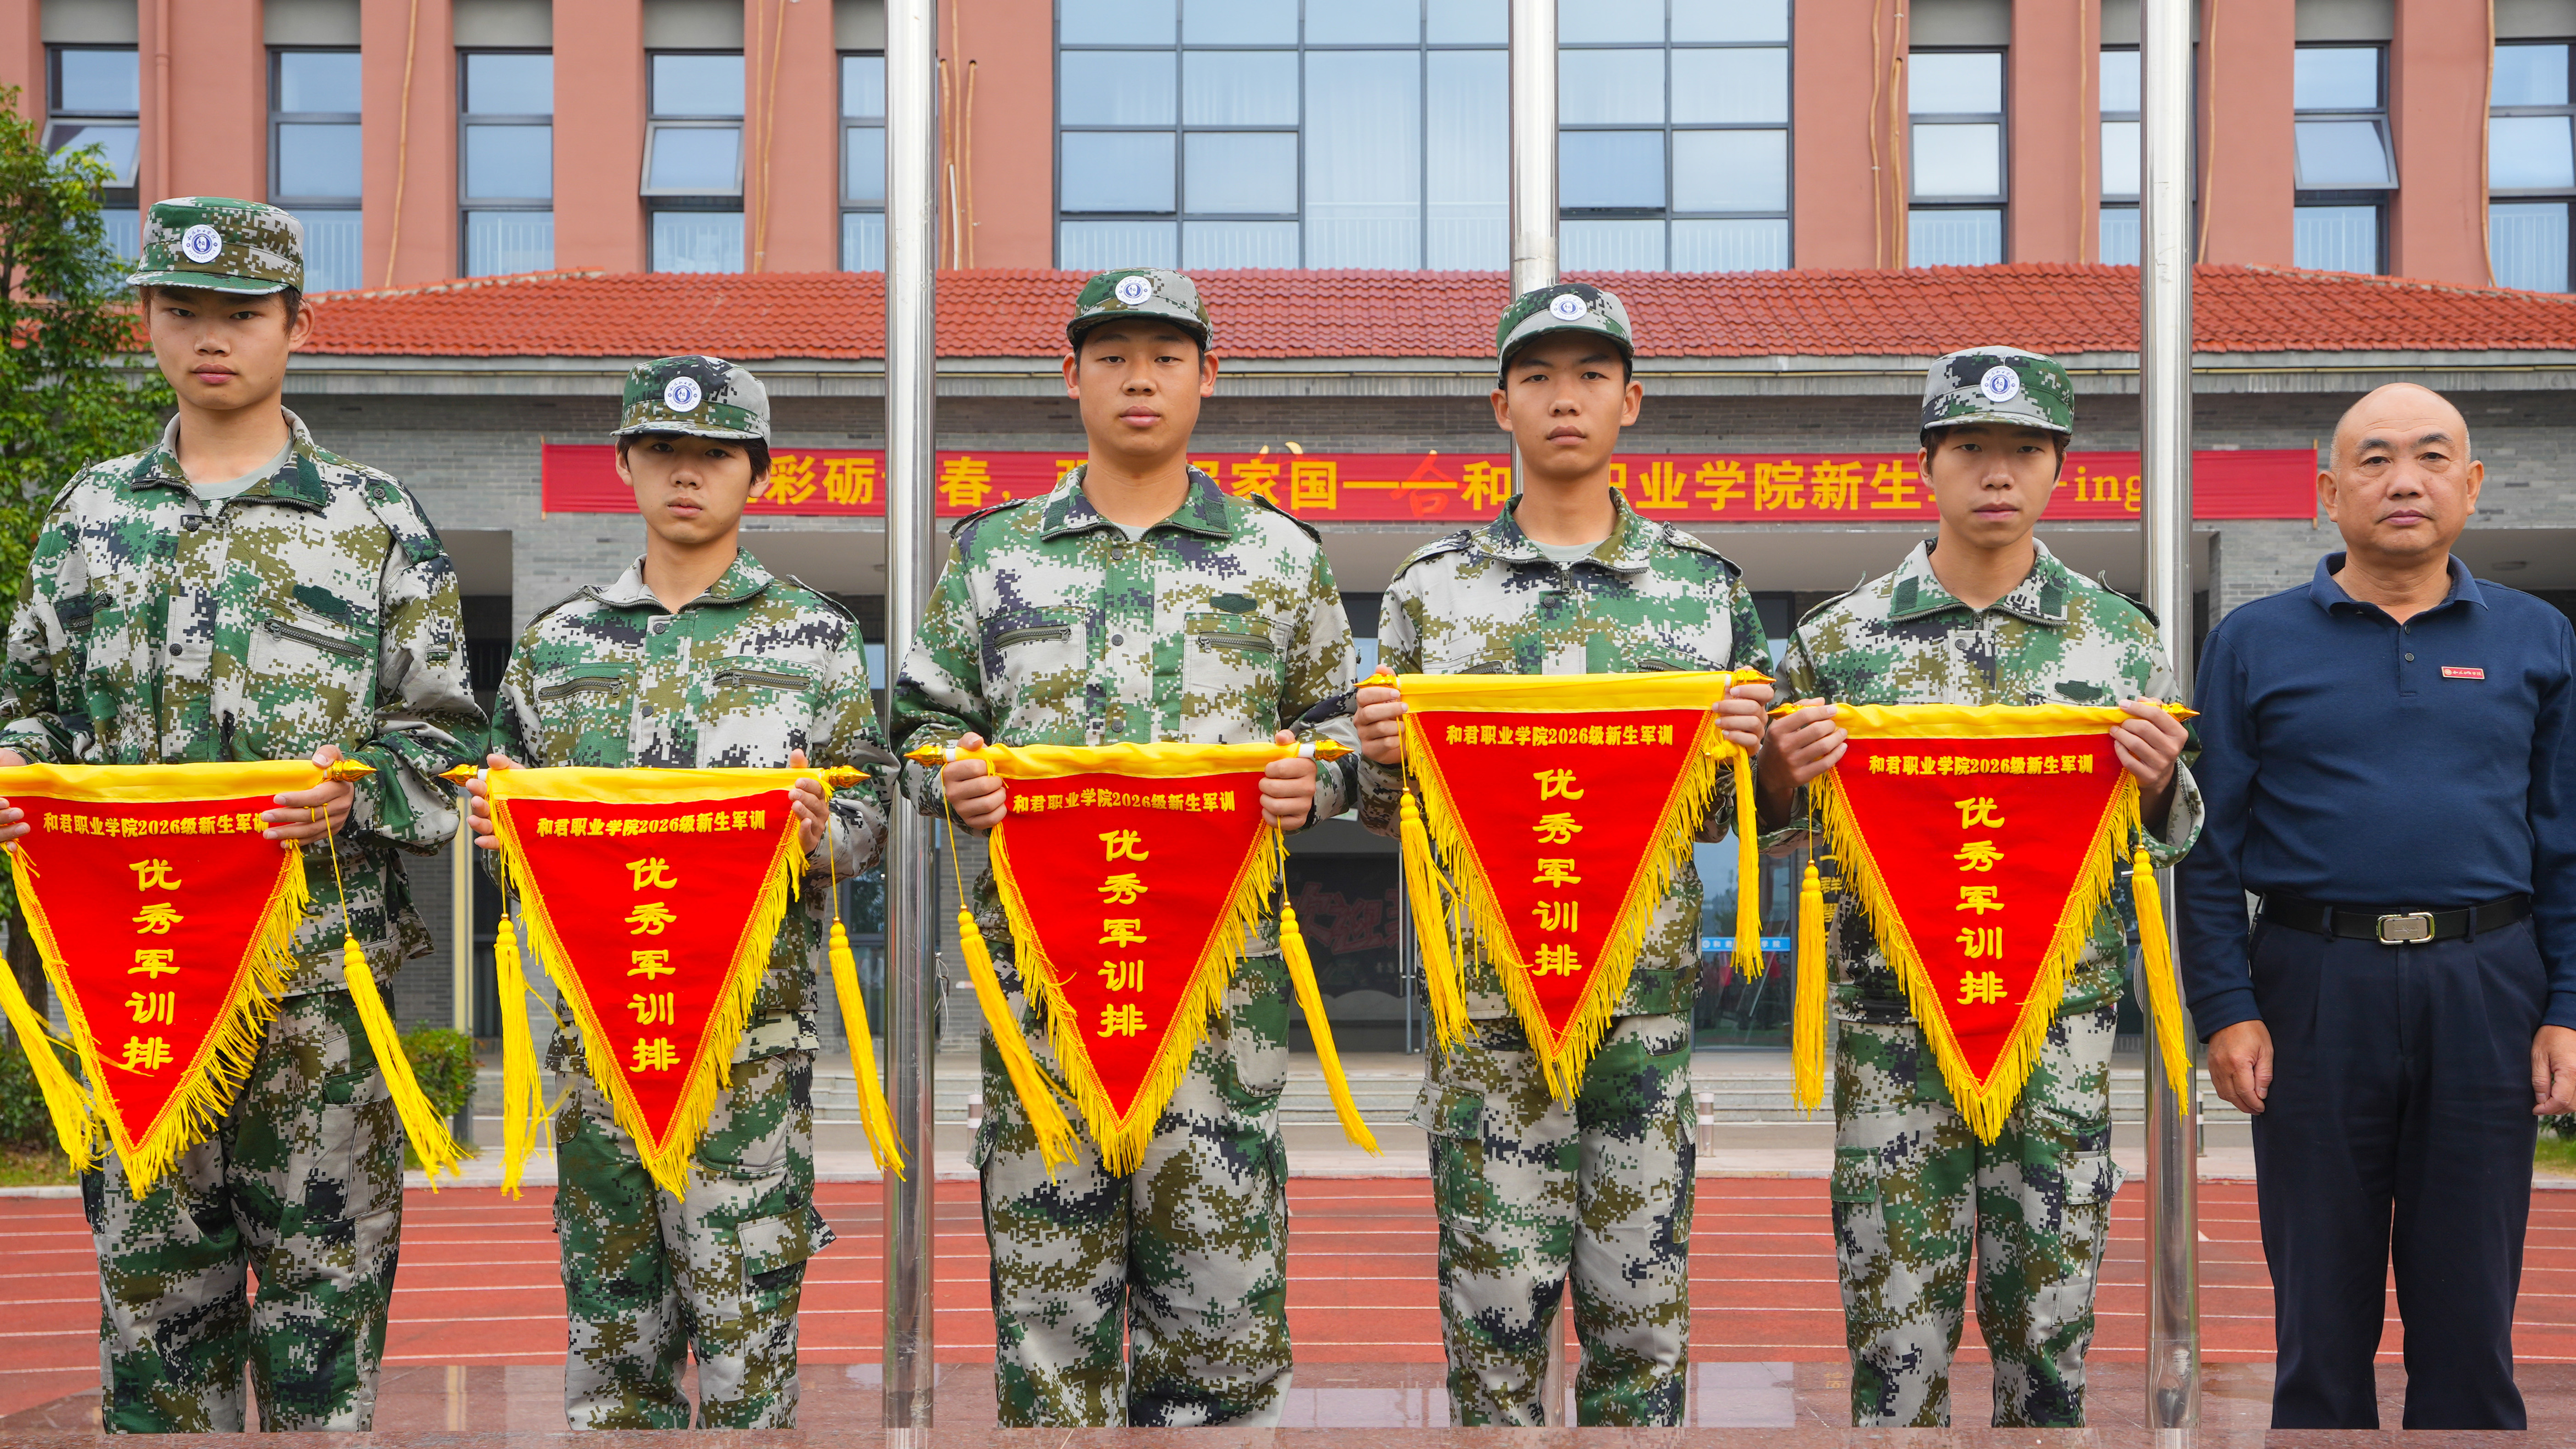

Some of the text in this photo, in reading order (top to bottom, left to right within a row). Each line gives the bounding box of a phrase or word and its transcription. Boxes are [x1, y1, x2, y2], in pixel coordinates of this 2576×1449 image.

[536, 810, 765, 838] 和君职业学院2026级新生军训
[1012, 788, 1236, 813] 和君职业学院2026级新生军训
[1446, 724, 1673, 747] 和君职业学院2026级新生军训
[1869, 754, 2093, 776] 和君职业学院2026级新生军训
[120, 858, 184, 1070] 优秀军训排
[625, 857, 680, 1073] 优秀军训排
[1097, 829, 1149, 1037] 优秀军训排
[1532, 768, 1584, 977] 优秀军训排
[1954, 797, 2008, 1005] 优秀军训排
